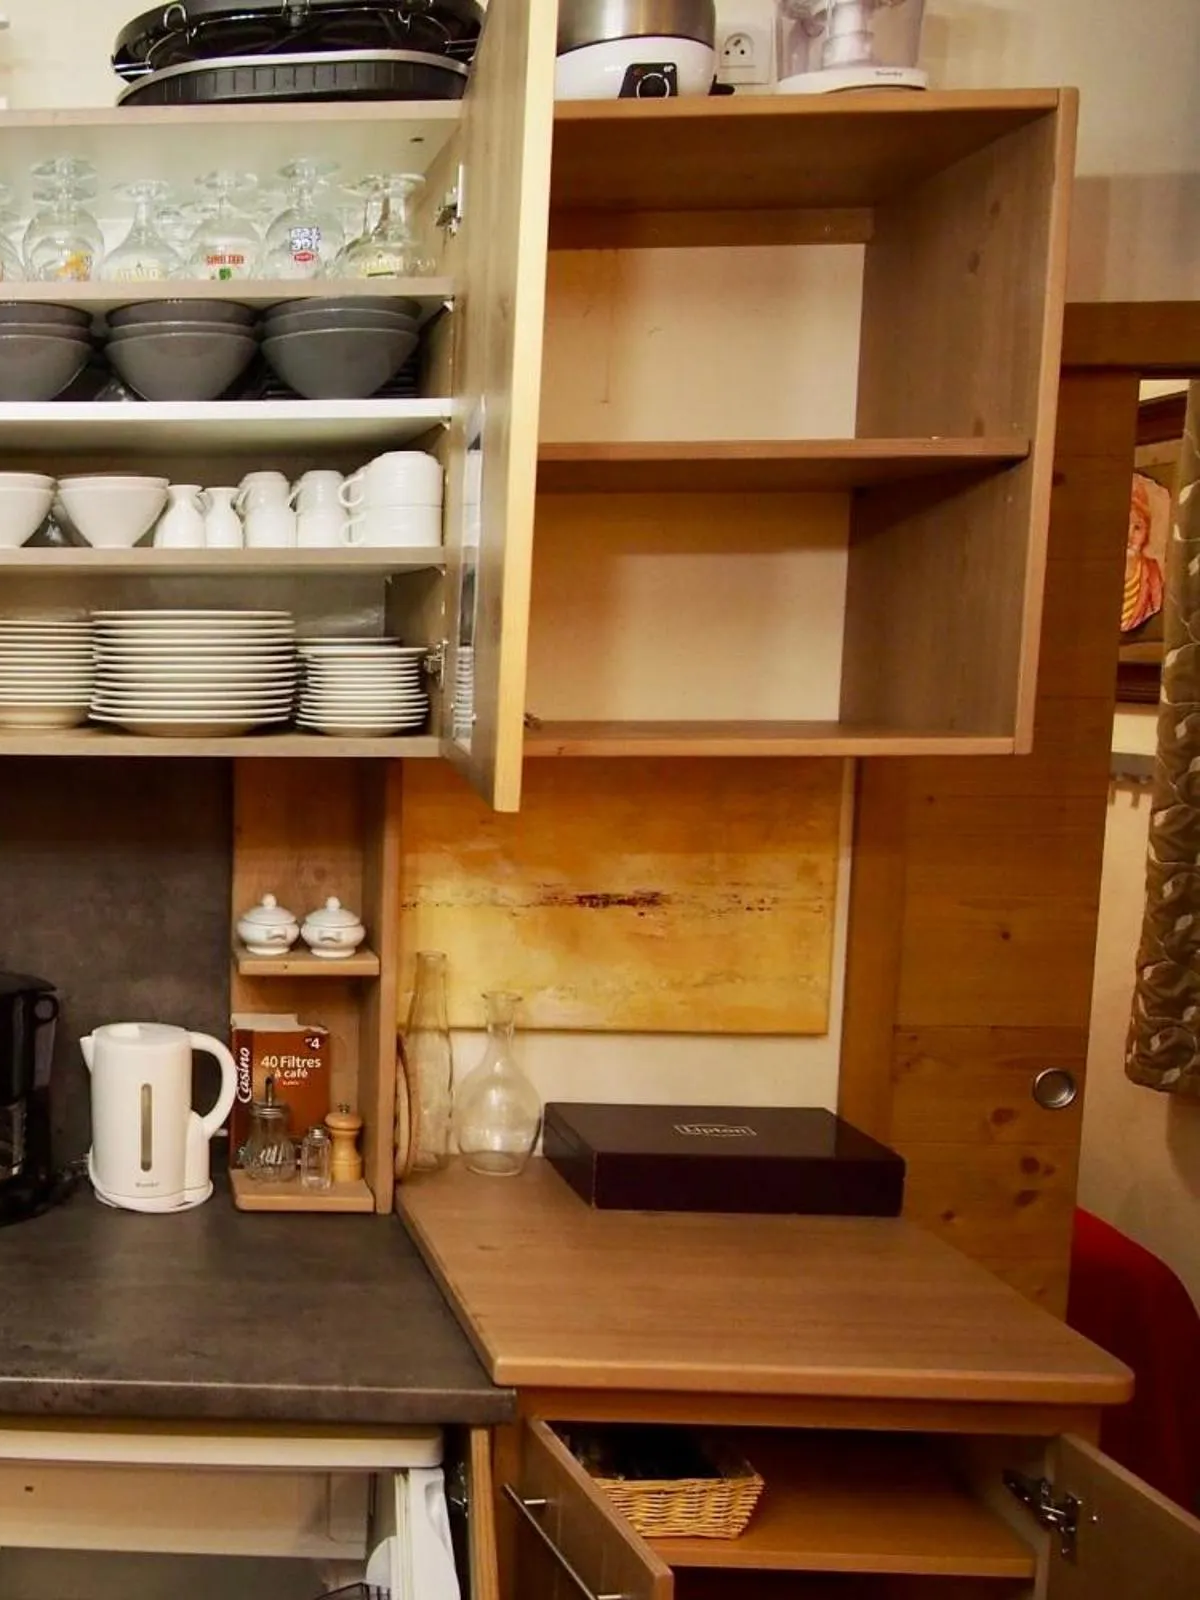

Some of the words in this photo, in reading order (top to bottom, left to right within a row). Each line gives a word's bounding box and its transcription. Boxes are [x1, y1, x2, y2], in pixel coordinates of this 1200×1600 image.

[260, 1055, 279, 1069] 40
[280, 1055, 322, 1069] Filtres
[236, 1047, 252, 1103] Casino
[284, 1067, 309, 1078] café
